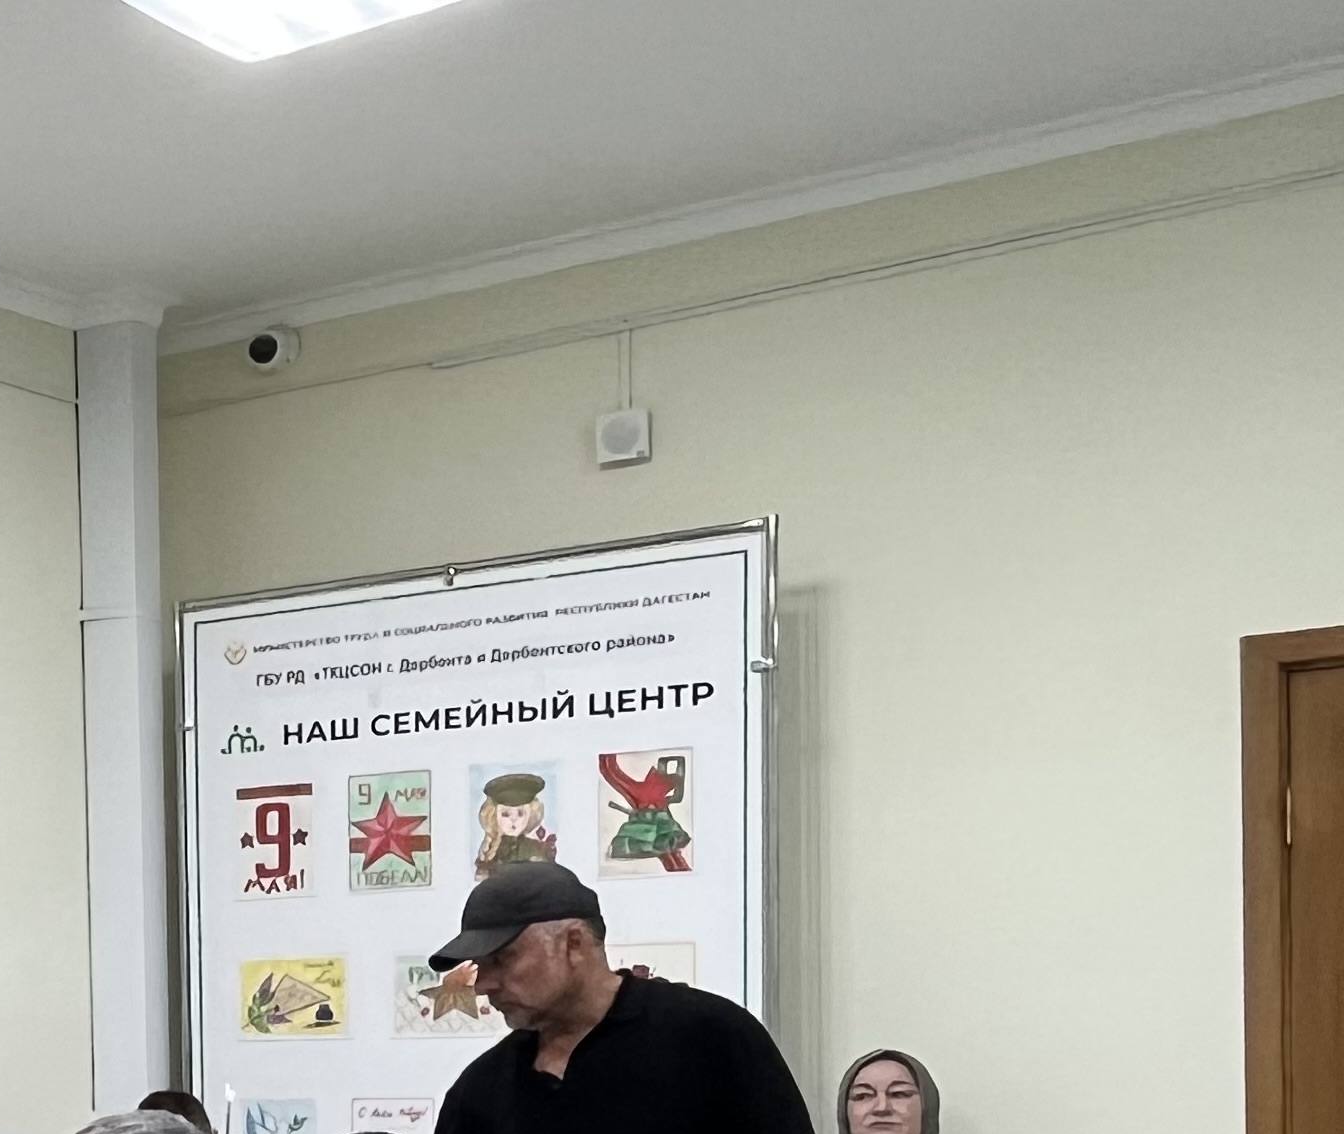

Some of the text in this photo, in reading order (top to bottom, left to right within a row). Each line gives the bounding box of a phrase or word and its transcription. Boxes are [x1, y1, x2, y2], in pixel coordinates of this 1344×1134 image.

[256, 672, 283, 687] ГБУ
[286, 669, 306, 685] РД
[490, 640, 601, 664] Дербентского
[283, 681, 715, 746] НАШ СЕМЕЙНЫЙ ЦЕНТР
[358, 783, 372, 806] 9
[256, 802, 291, 879] 9
